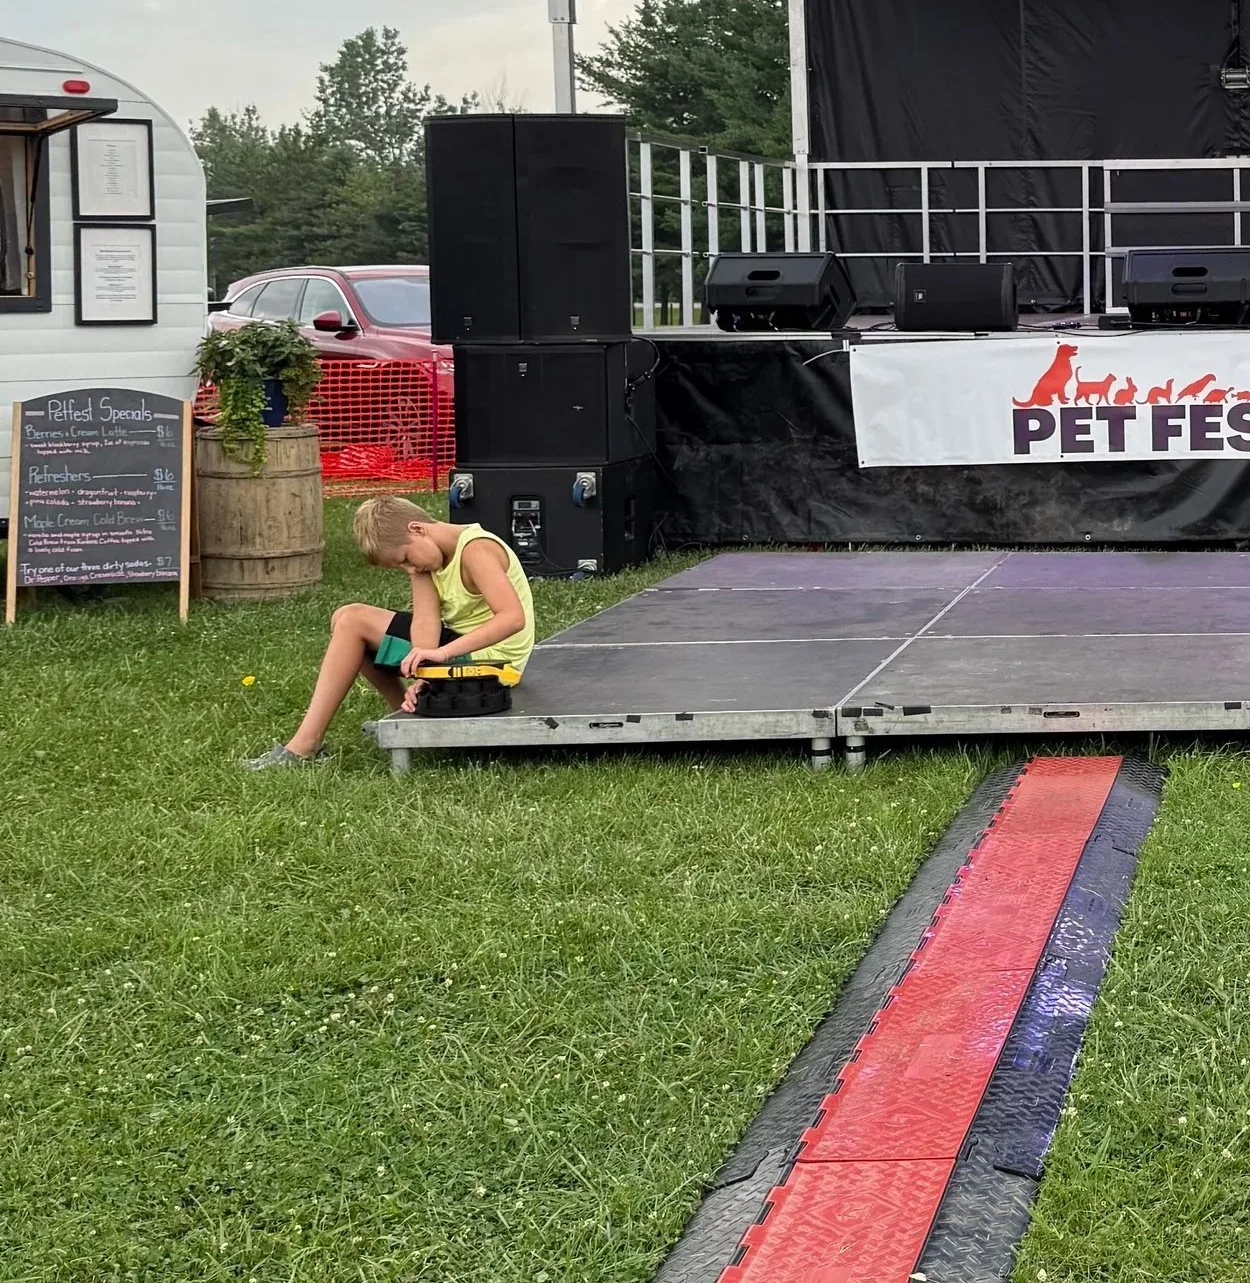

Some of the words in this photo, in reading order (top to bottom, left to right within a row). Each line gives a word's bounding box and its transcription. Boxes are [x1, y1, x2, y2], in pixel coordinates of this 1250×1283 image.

[48, 398, 92, 422] Petfest
[100, 397, 152, 423] Specials
[25, 424, 63, 439] Berries
[70, 426, 98, 437] Cream
[101, 425, 128, 437] Latte
[157, 425, 174, 438] $6
[1012, 405, 1136, 455] PET
[29, 465, 91, 485] Refreshers
[153, 468, 175, 481] $6
[29, 488, 70, 496] watermelon
[77, 488, 118, 498] dragonfruit
[57, 513, 89, 527] Cream
[93, 513, 115, 526] Cold
[157, 509, 175, 521] $6
[20, 563, 37, 577] Try
[55, 563, 65, 572] of
[103, 561, 124, 571] dirty
[156, 557, 172, 566] $7
